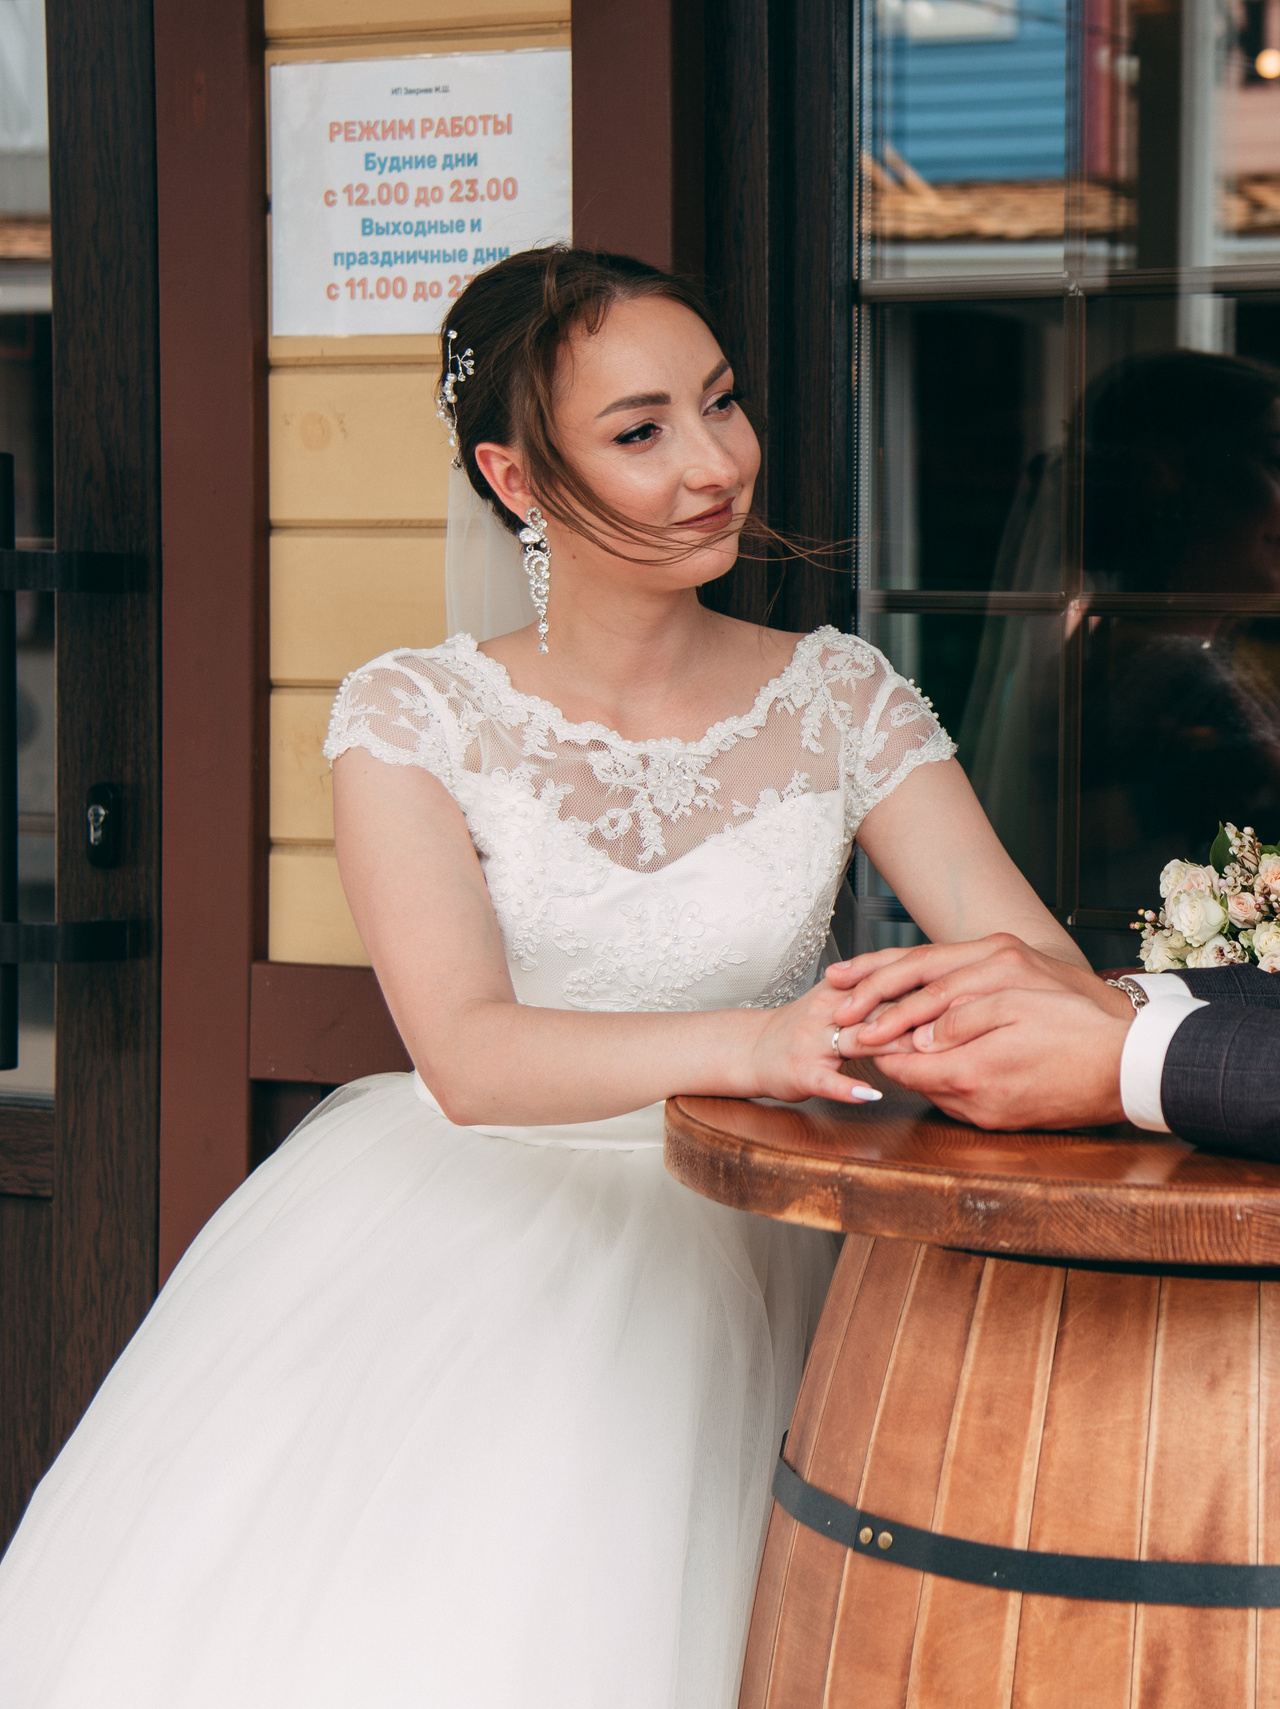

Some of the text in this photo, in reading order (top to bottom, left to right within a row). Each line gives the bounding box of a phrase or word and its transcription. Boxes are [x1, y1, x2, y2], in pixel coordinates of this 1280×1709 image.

[329, 113, 513, 142] РЕЖИМ РАБОТЫ
[364, 152, 478, 175] Будние дни
[323, 177, 518, 208] с 12.00 до 23.00
[361, 217, 482, 238] Выходные и
[333, 246, 511, 270] праздничные дни
[326, 283, 337, 300] с
[344, 277, 407, 300] 11.00
[412, 281, 442, 303] до
